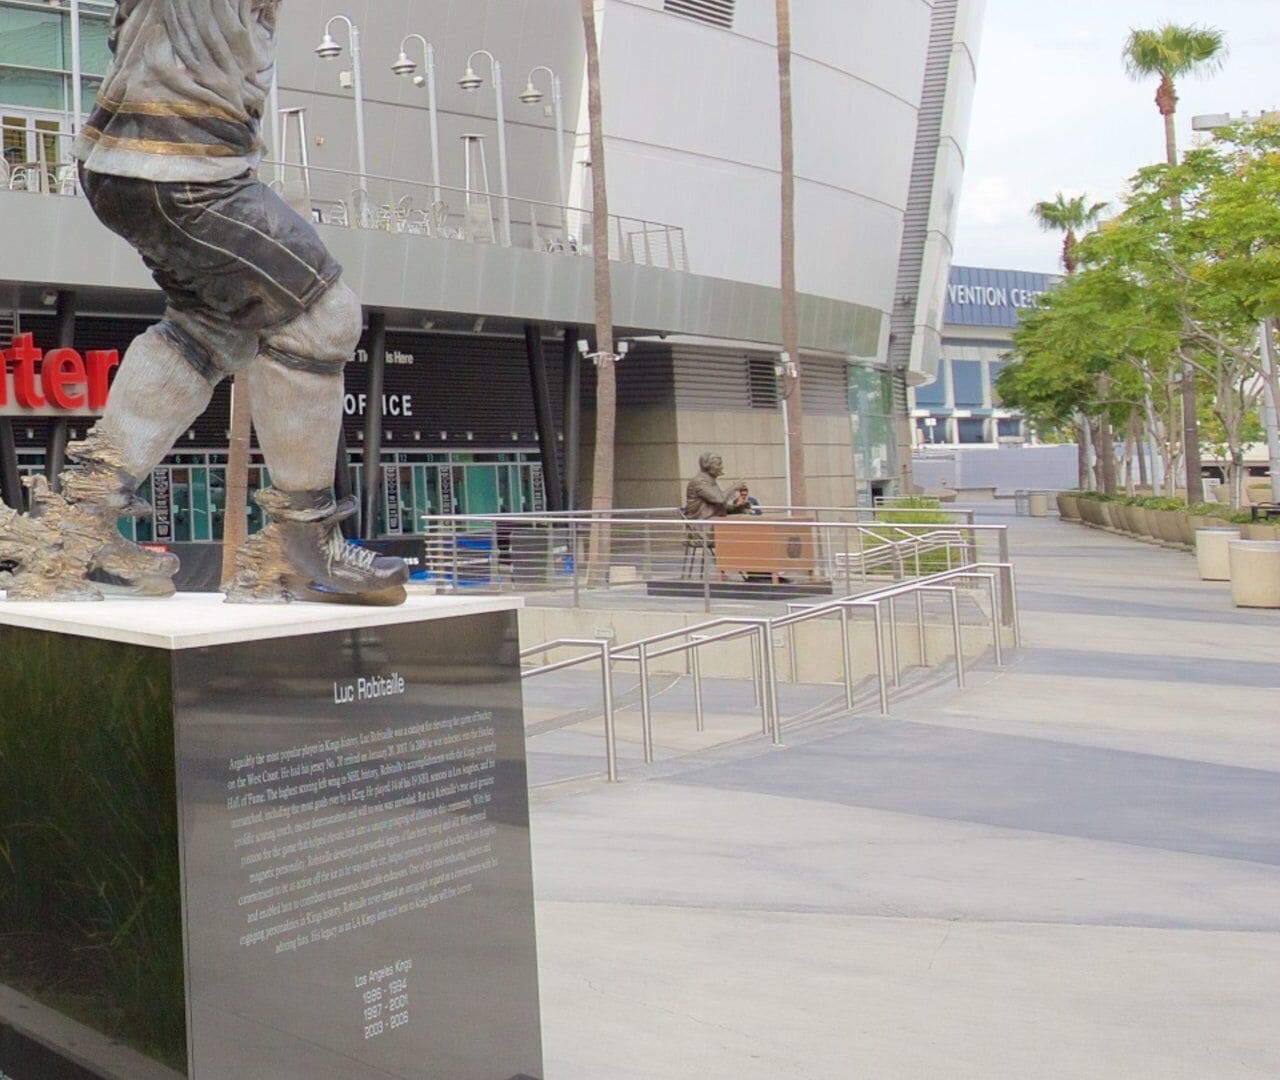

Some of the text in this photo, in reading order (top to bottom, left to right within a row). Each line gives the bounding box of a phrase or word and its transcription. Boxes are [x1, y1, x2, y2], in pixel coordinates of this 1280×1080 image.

[344, 394, 413, 416] OFICE
[333, 672, 405, 705] Luc Robitaille
[369, 966, 393, 982] Angeles
[363, 987, 382, 1003] 1986
